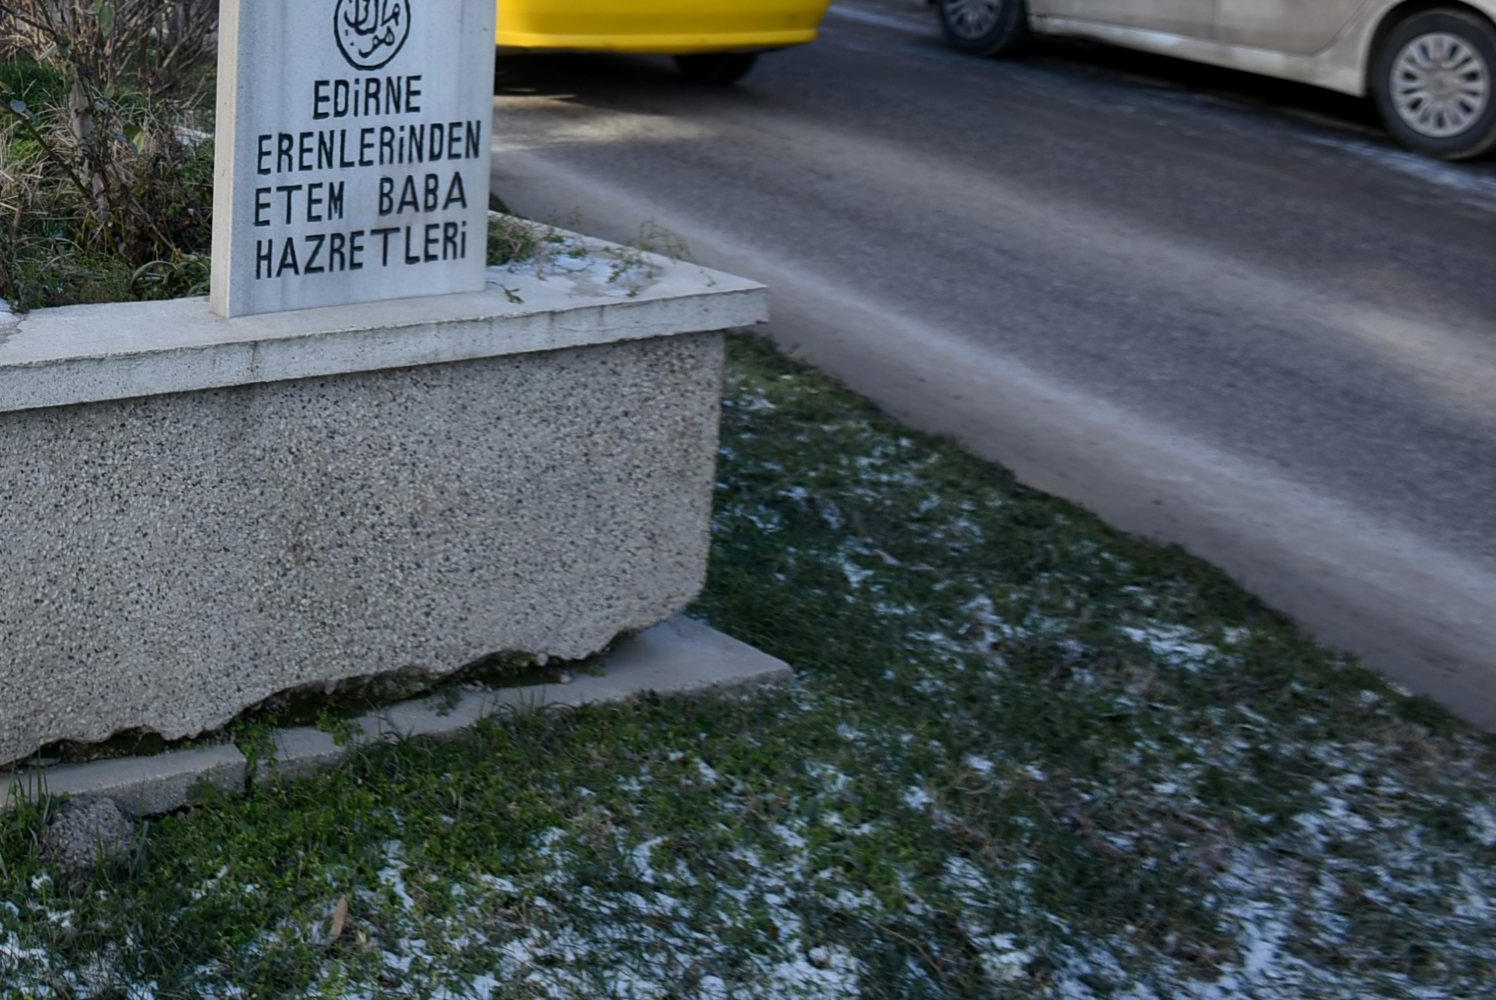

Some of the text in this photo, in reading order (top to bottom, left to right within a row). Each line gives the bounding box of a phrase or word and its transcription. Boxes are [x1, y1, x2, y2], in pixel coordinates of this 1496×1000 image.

[313, 75, 422, 120] EDİRNE
[257, 120, 481, 176] ERENLERİNDEN
[254, 171, 468, 227] ETEM BABA
[255, 220, 467, 280] HAZRETLERİ
